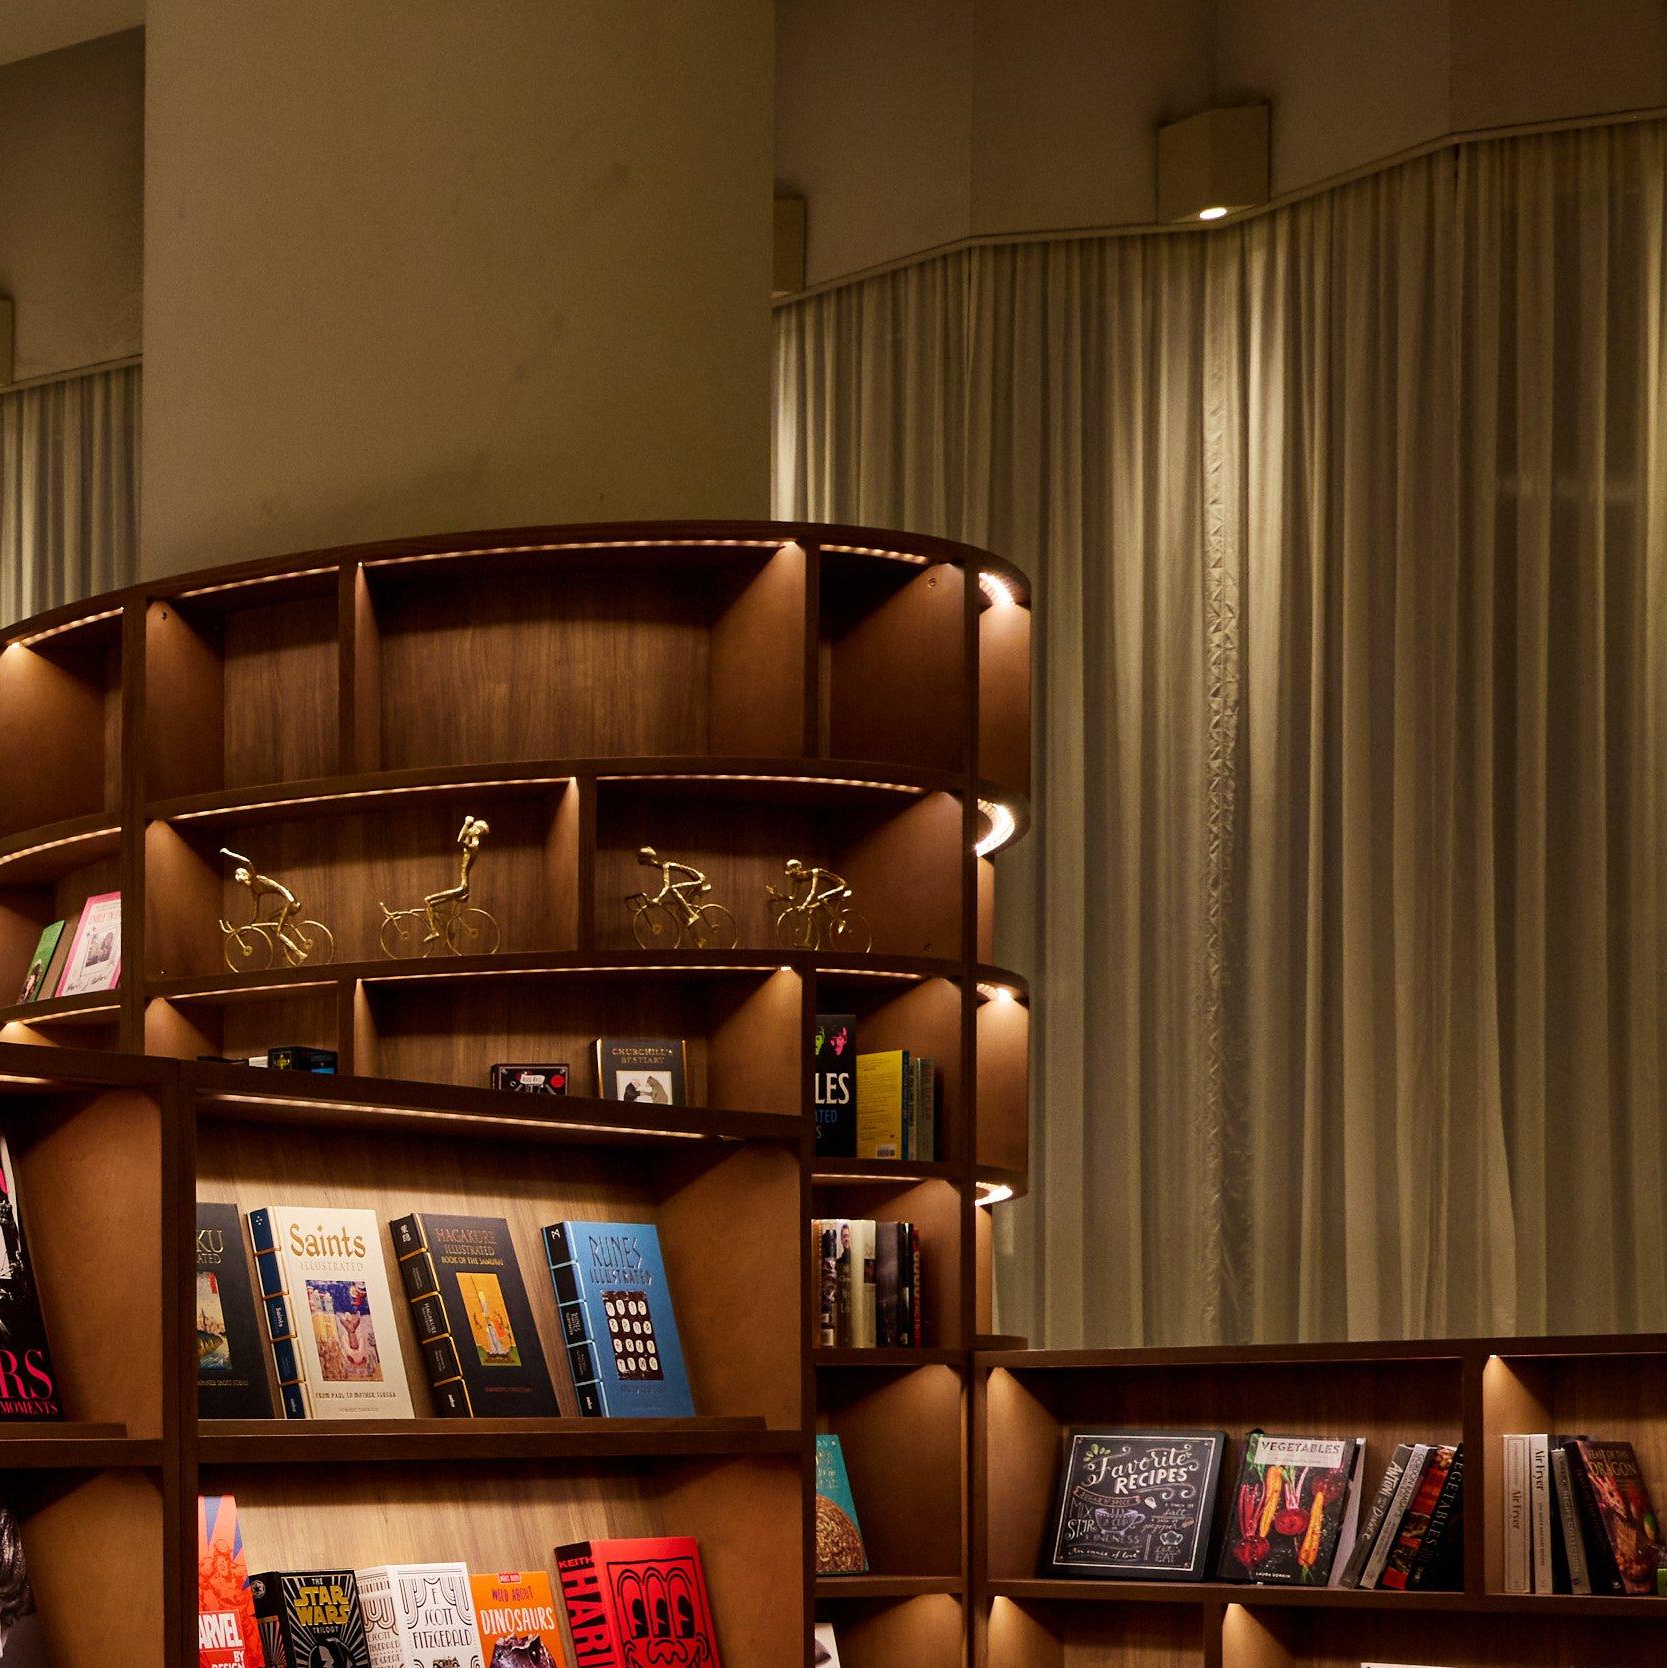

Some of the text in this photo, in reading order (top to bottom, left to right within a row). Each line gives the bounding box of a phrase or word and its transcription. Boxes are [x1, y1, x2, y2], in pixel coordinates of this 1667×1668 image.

[815, 1072, 850, 1104] LES
[289, 1223, 366, 1258] Saints
[588, 1236, 642, 1268] RUNES
[1261, 1441, 1341, 1454] VEGETABLES
[1082, 1447, 1193, 1486] Favorite
[1535, 1450, 1544, 1491] Air Fryer
[1115, 1468, 1188, 1494] RECIPES
[558, 1556, 592, 1569] KEITH
[294, 1586, 349, 1607] STAR
[297, 1605, 351, 1626] WARS
[480, 1607, 555, 1635] DINOSAURS
[413, 1629, 472, 1649] FITZGERALD
[234, 1652, 244, 1662] BY
